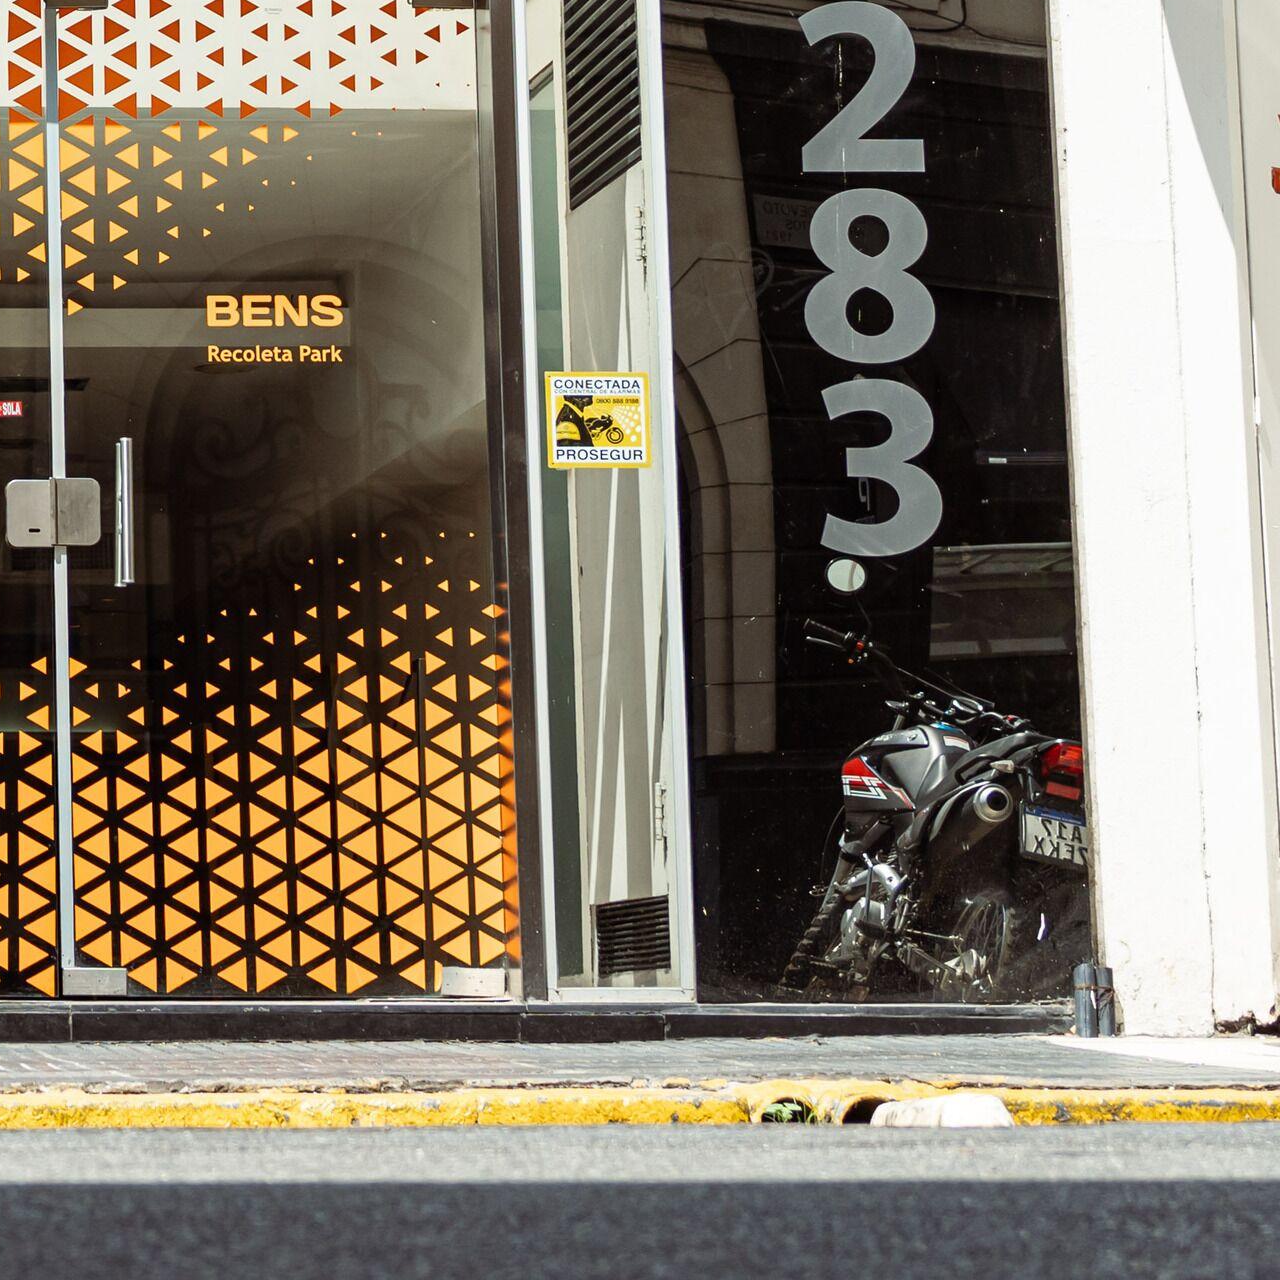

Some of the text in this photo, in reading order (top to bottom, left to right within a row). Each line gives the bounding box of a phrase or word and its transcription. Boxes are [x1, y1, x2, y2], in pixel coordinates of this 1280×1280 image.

[206, 294, 344, 327] BENS
[207, 344, 343, 363] Recoleta Park
[554, 379, 640, 389] CONECTADA
[2, 402, 22, 416] SOLA
[556, 449, 643, 460] PROSEGUR
